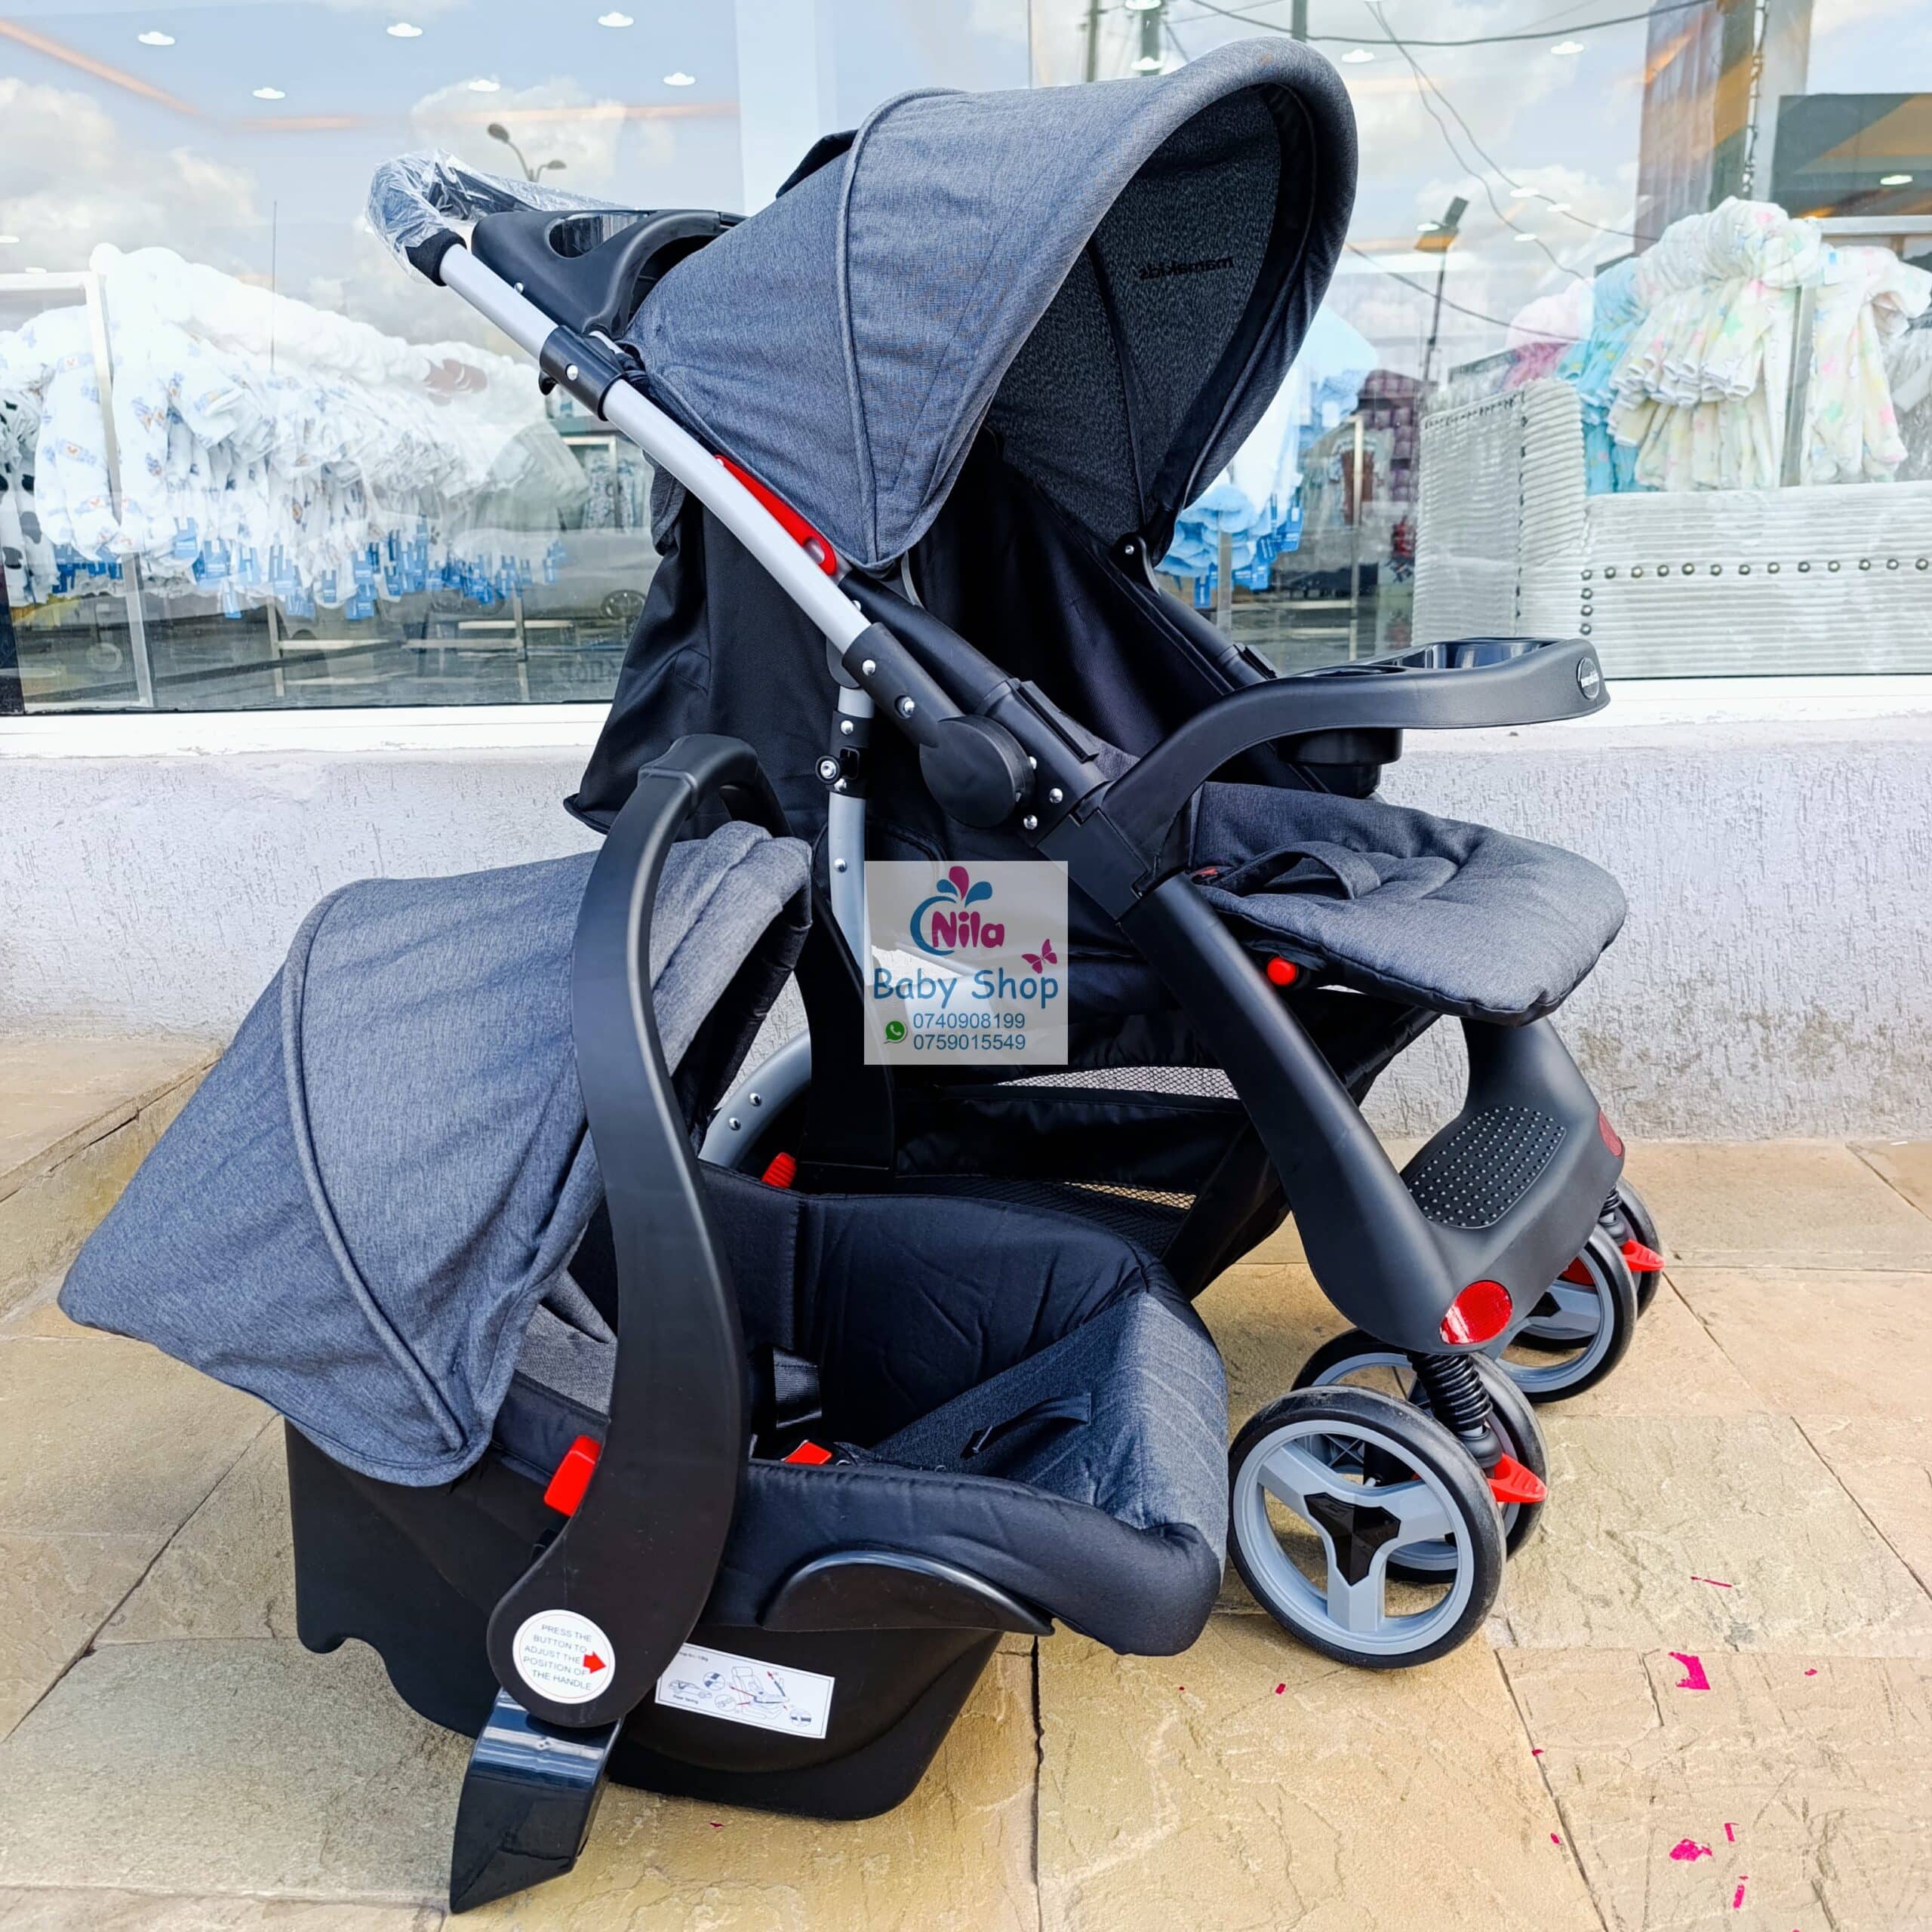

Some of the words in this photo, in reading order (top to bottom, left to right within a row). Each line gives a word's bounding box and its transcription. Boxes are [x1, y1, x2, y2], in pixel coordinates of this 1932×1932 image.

[541, 1623, 573, 1638] PRESS
[574, 1631, 592, 1642] THE
[533, 1635, 572, 1649] BUTTON
[574, 1644, 587, 1653] TO
[525, 1645, 561, 1658] ADJUST
[564, 1654, 580, 1664] THE
[523, 1656, 572, 1673] POSITION
[574, 1668, 589, 1676] OF
[532, 1669, 551, 1680] THE
[553, 1675, 592, 1690] HANDLE
